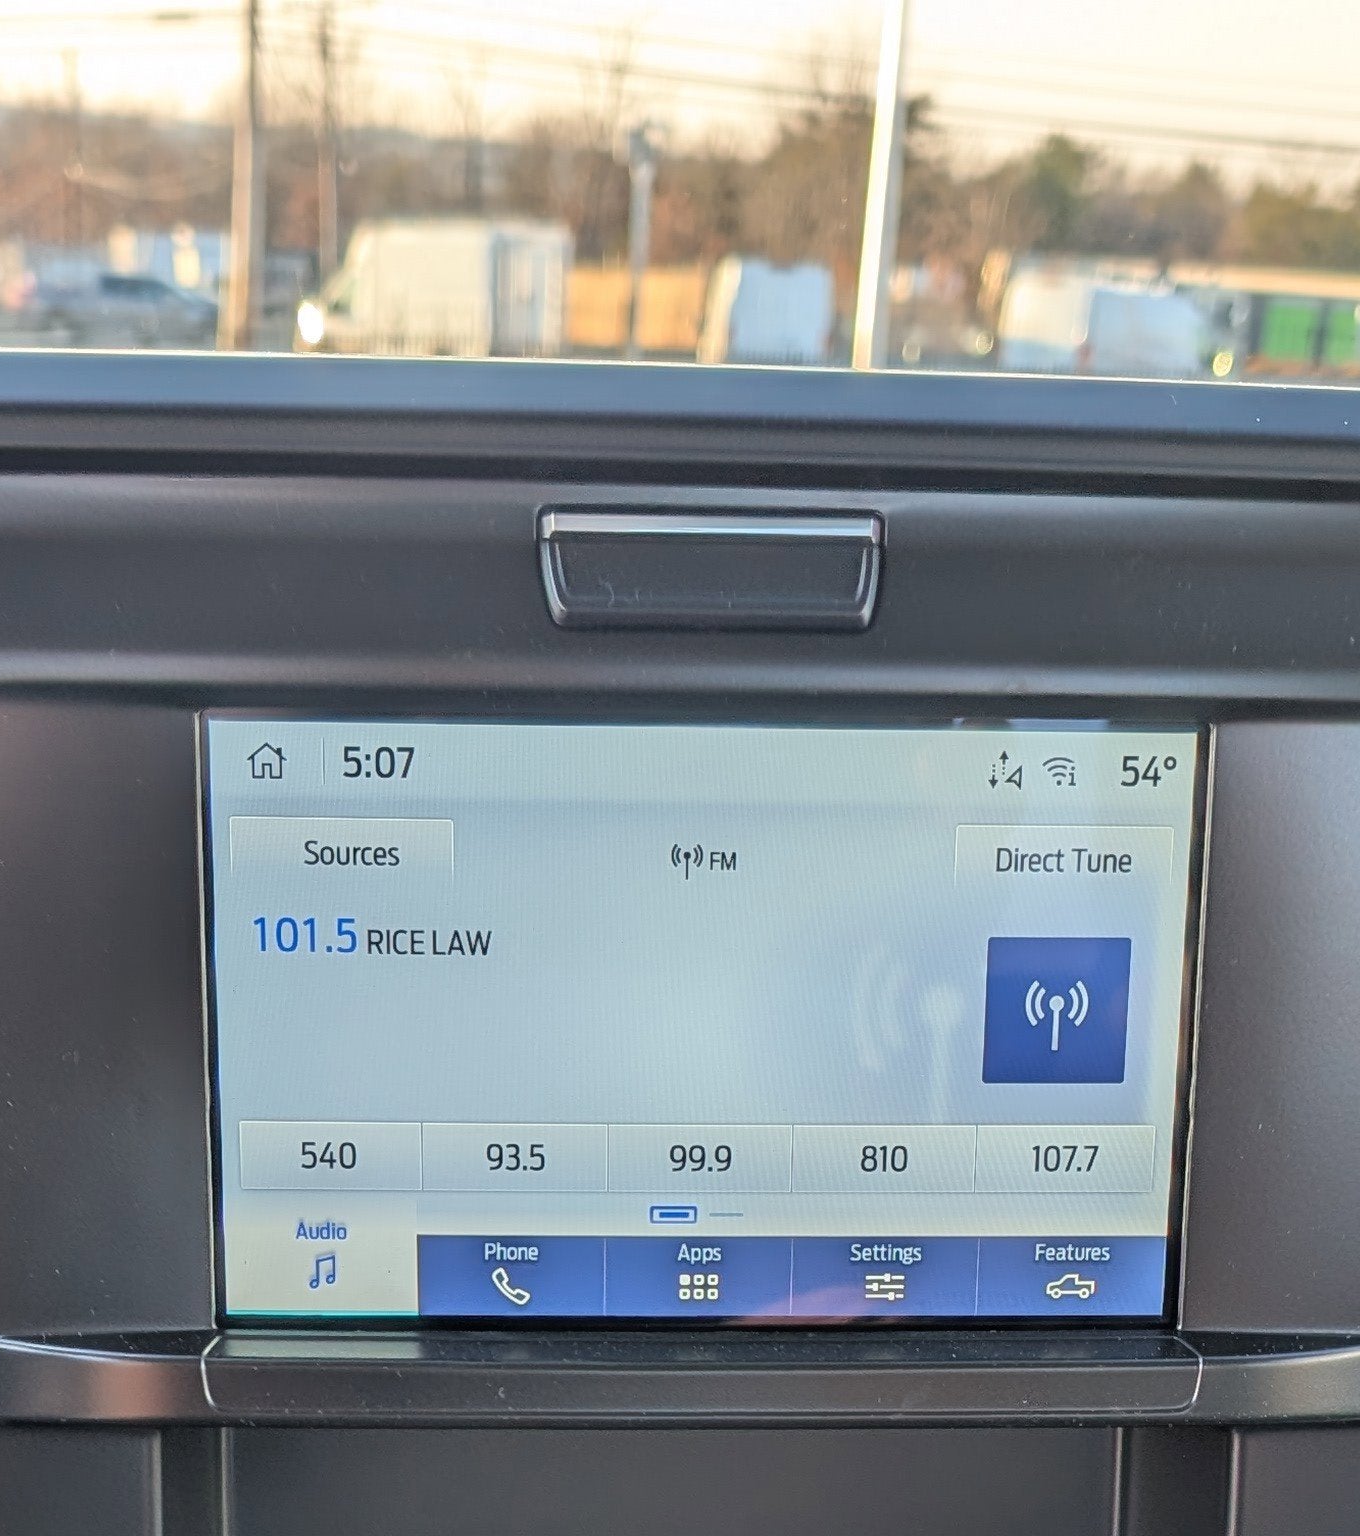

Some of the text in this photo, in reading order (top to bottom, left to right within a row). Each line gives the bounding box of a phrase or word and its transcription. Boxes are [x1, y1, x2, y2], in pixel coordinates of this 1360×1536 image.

[341, 745, 416, 779] 5:07
[1120, 754, 1178, 788] 54°
[303, 840, 400, 867] Sources
[709, 852, 737, 871] FM
[995, 847, 1133, 874] Direct Tune
[252, 916, 492, 956] 101.5 RICE LAW
[300, 1140, 358, 1170] 540
[486, 1143, 546, 1172] 93.5
[669, 1144, 733, 1173] 99.9
[860, 1144, 909, 1173] 810
[1031, 1144, 1100, 1173] 107.7
[295, 1222, 348, 1241] Audio
[484, 1243, 539, 1262] Phone
[677, 1243, 722, 1265] Apps
[849, 1243, 923, 1265] Settings
[1034, 1243, 1111, 1263] Features
